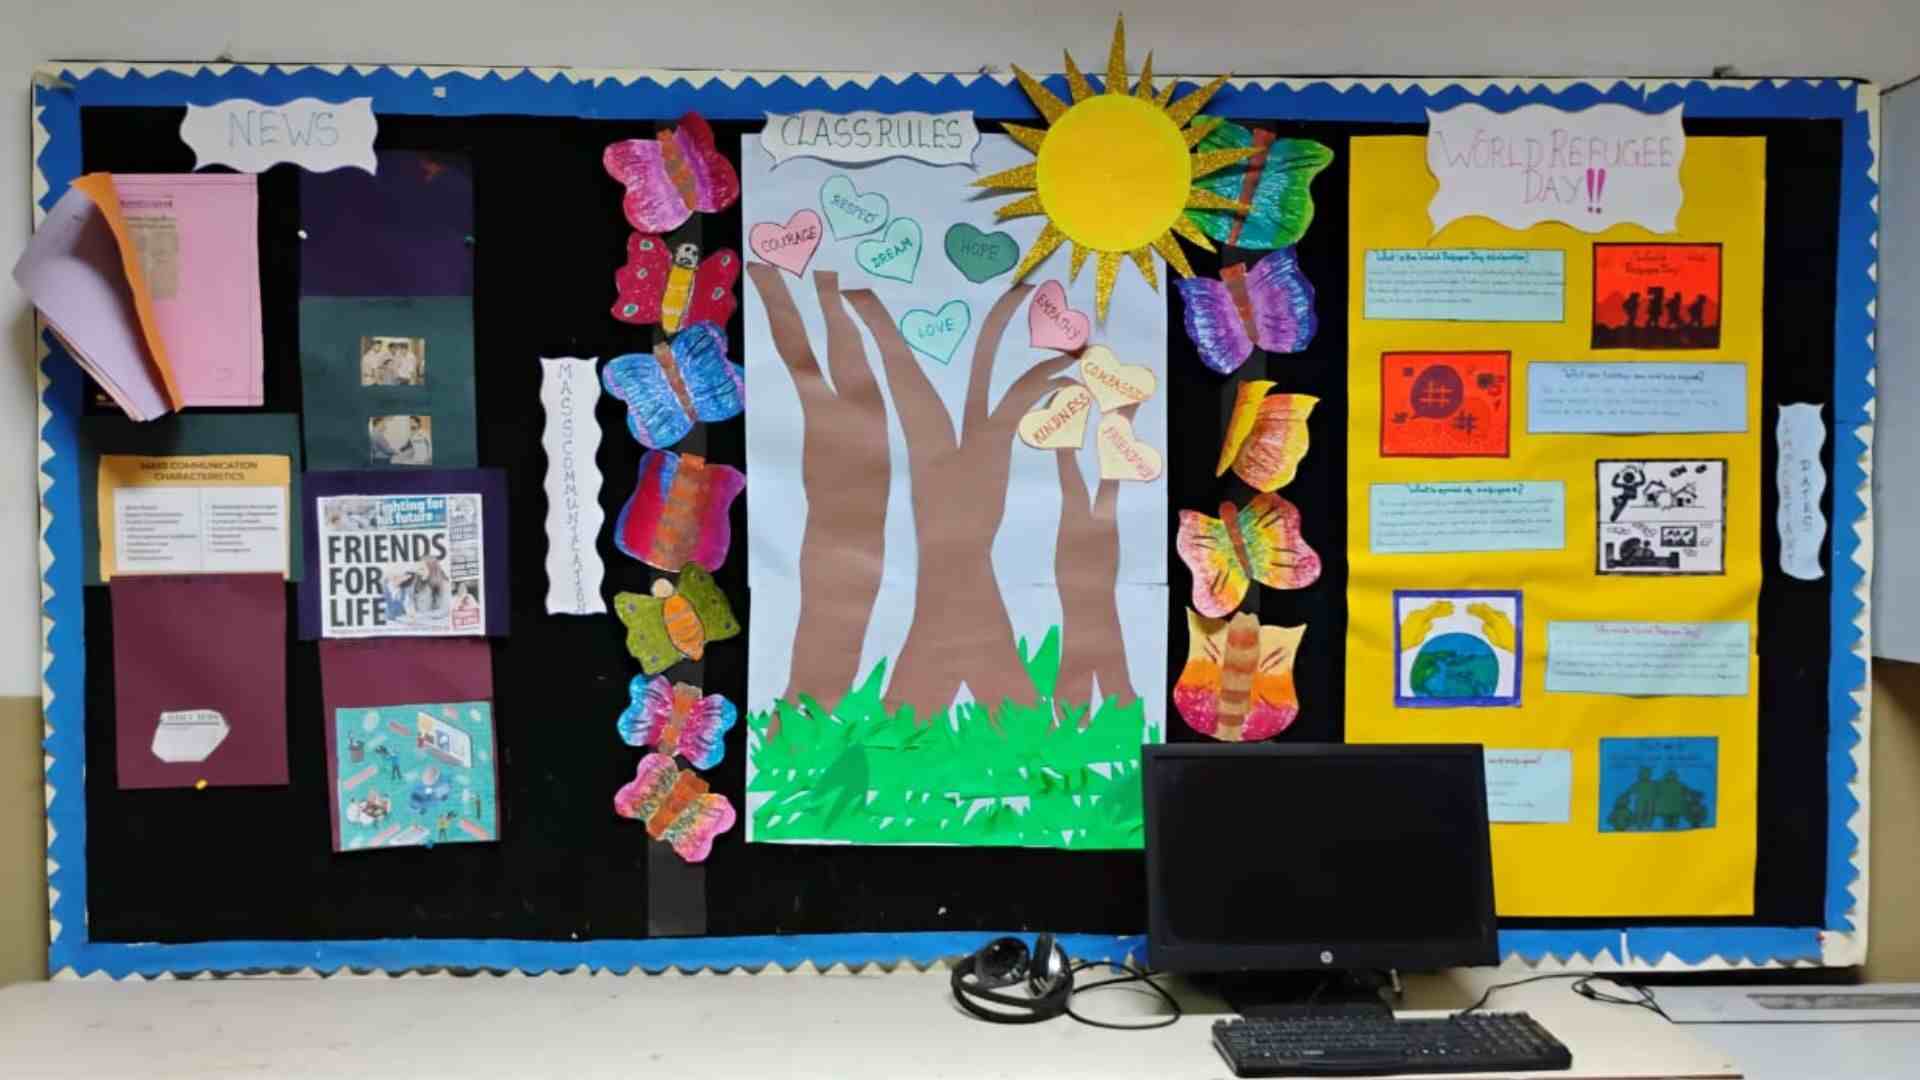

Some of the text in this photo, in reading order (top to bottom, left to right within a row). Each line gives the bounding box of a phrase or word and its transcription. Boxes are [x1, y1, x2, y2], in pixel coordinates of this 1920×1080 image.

[228, 110, 339, 147] NEWS
[781, 116, 962, 148] CLASS RULES
[1435, 128, 1674, 169] WORLD REFUGEE
[760, 225, 818, 253] COURAGE
[870, 237, 914, 269] DREAM
[960, 241, 1000, 261] HOPE
[917, 318, 955, 339] LOVE
[1035, 294, 1082, 341] EMPATHY
[1032, 392, 1092, 445] KINDNESS
[153, 471, 245, 481] CHARACTERISTICS
[167, 460, 258, 470] COMMUNICATION
[427, 497, 444, 510] for
[328, 533, 447, 564] FRIENDS
[329, 566, 383, 596] FOR
[330, 597, 386, 627] LIFE
